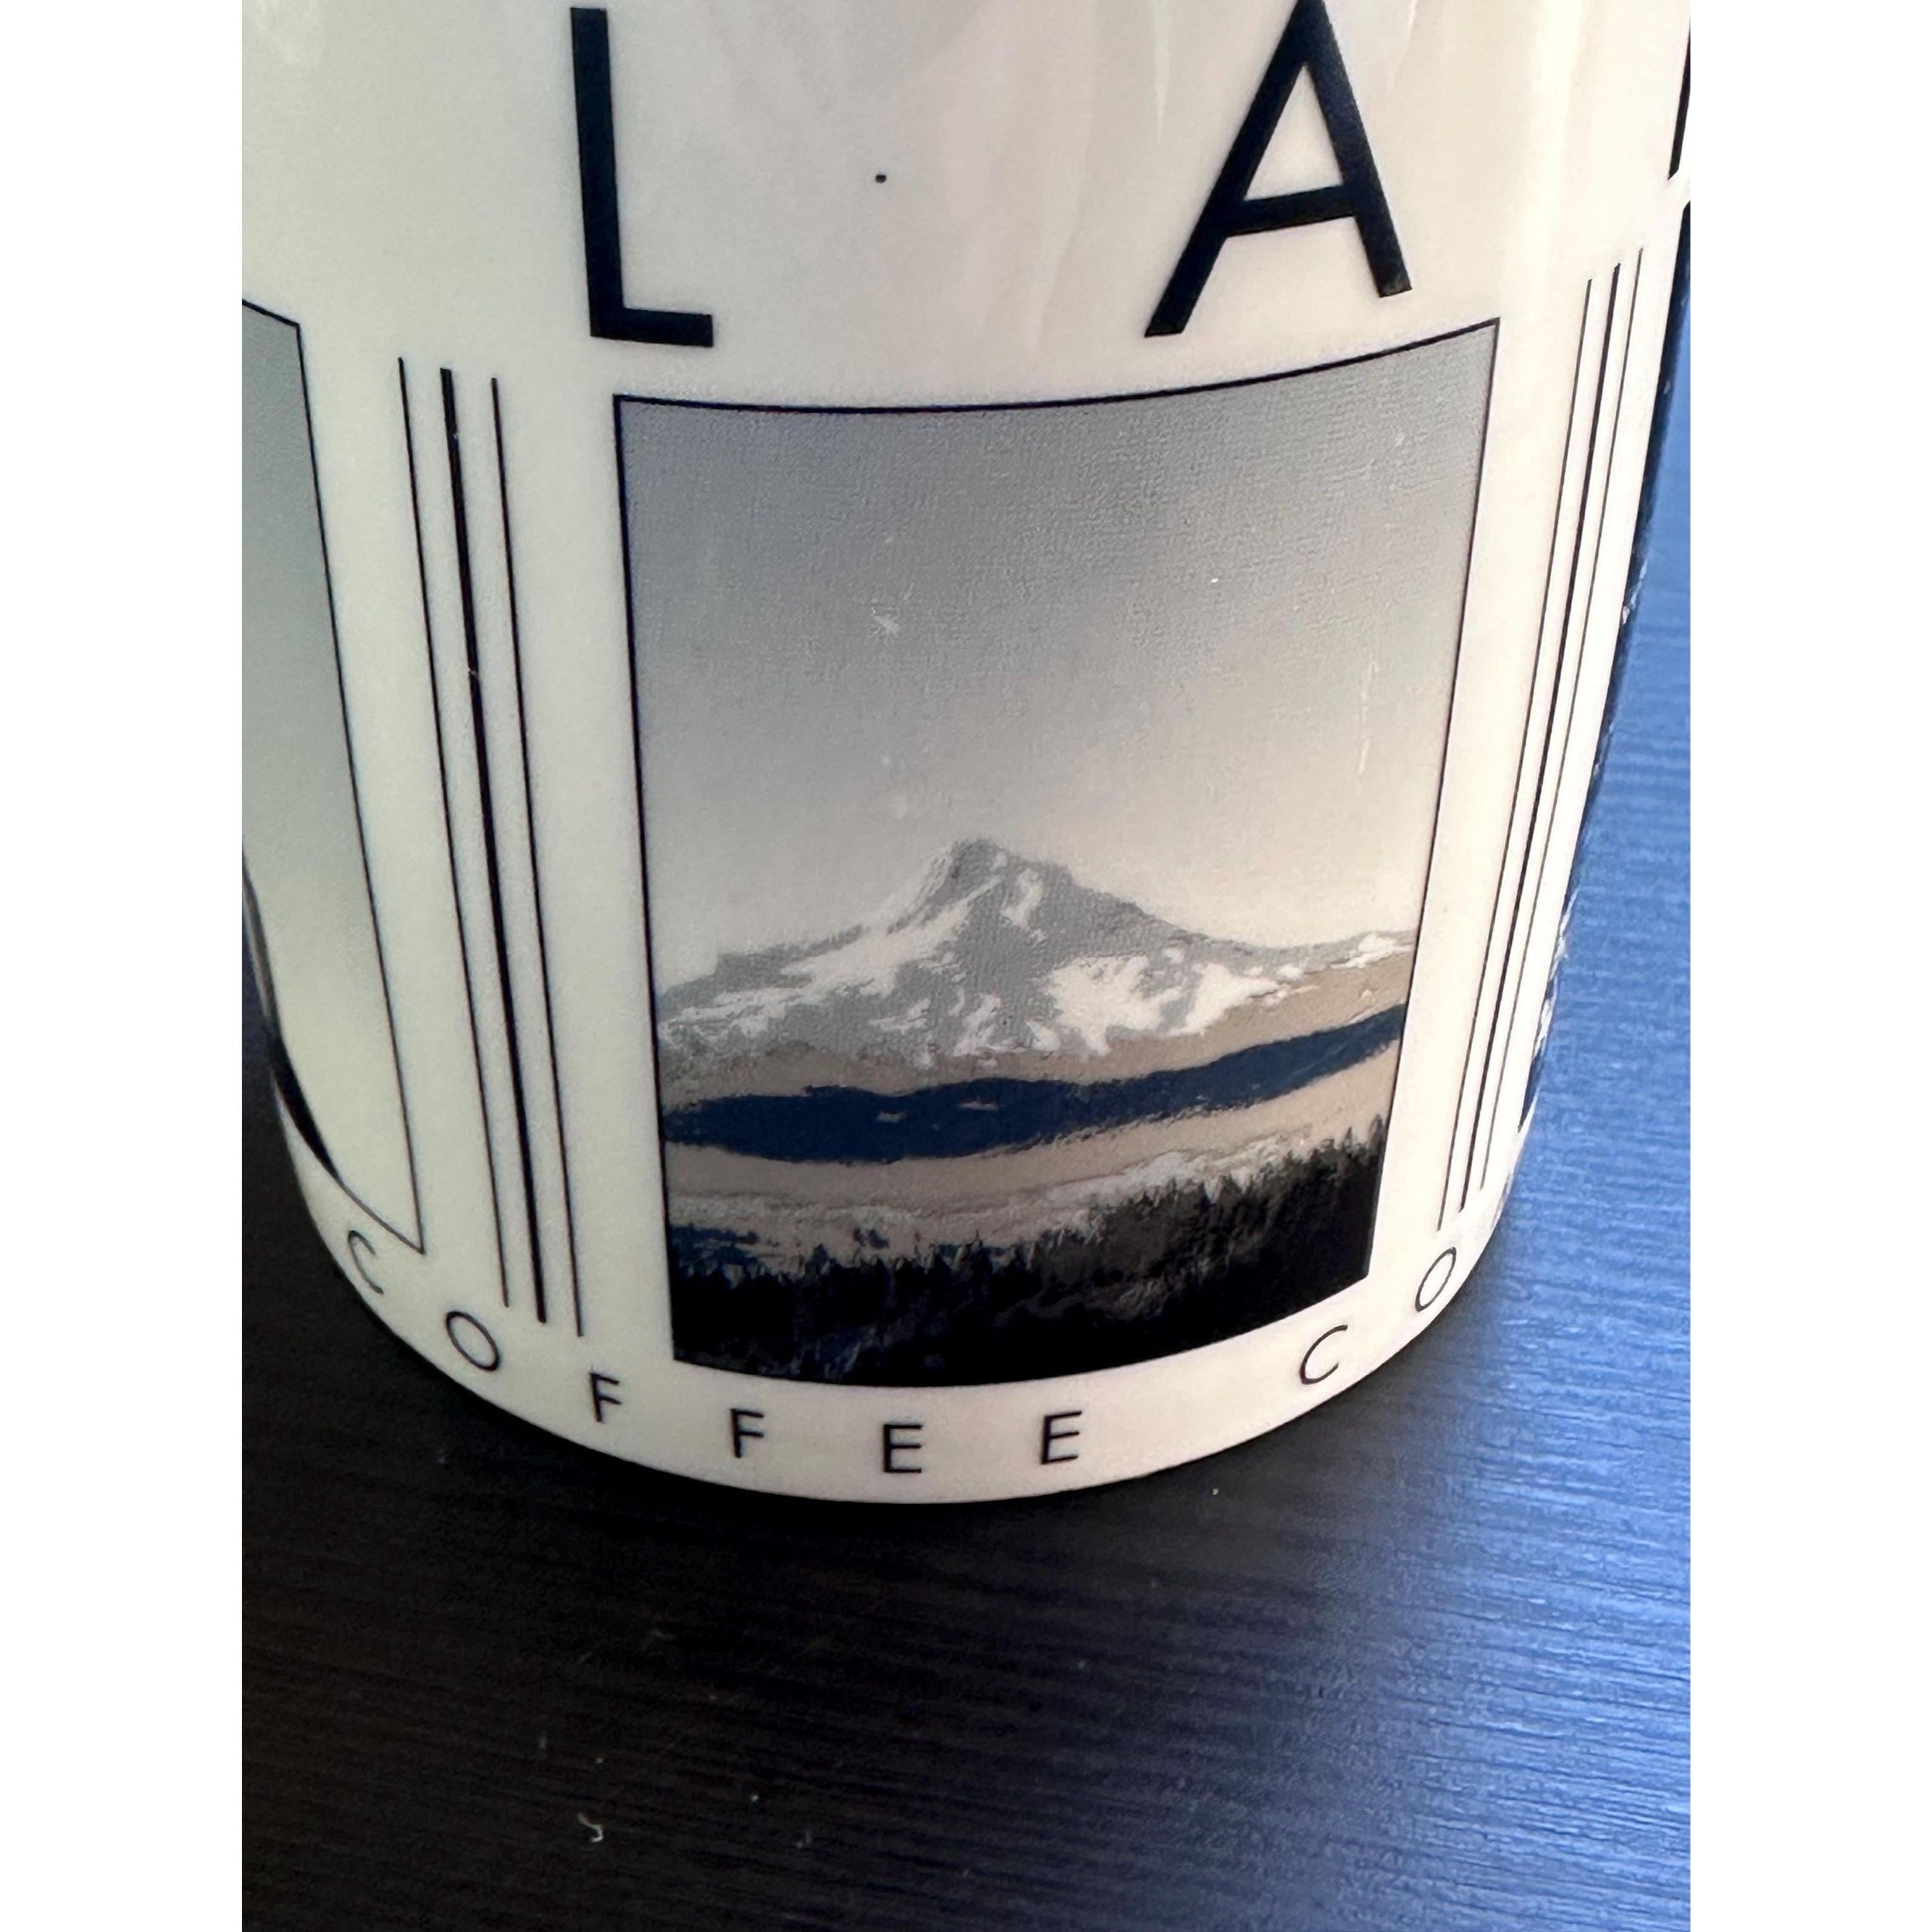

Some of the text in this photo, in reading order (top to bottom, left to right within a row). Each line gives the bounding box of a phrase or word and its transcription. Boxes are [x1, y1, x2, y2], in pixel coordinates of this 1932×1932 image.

[570, 0, 1690, 346] LA
[348, 1229, 1457, 1474] COFFEE CO
